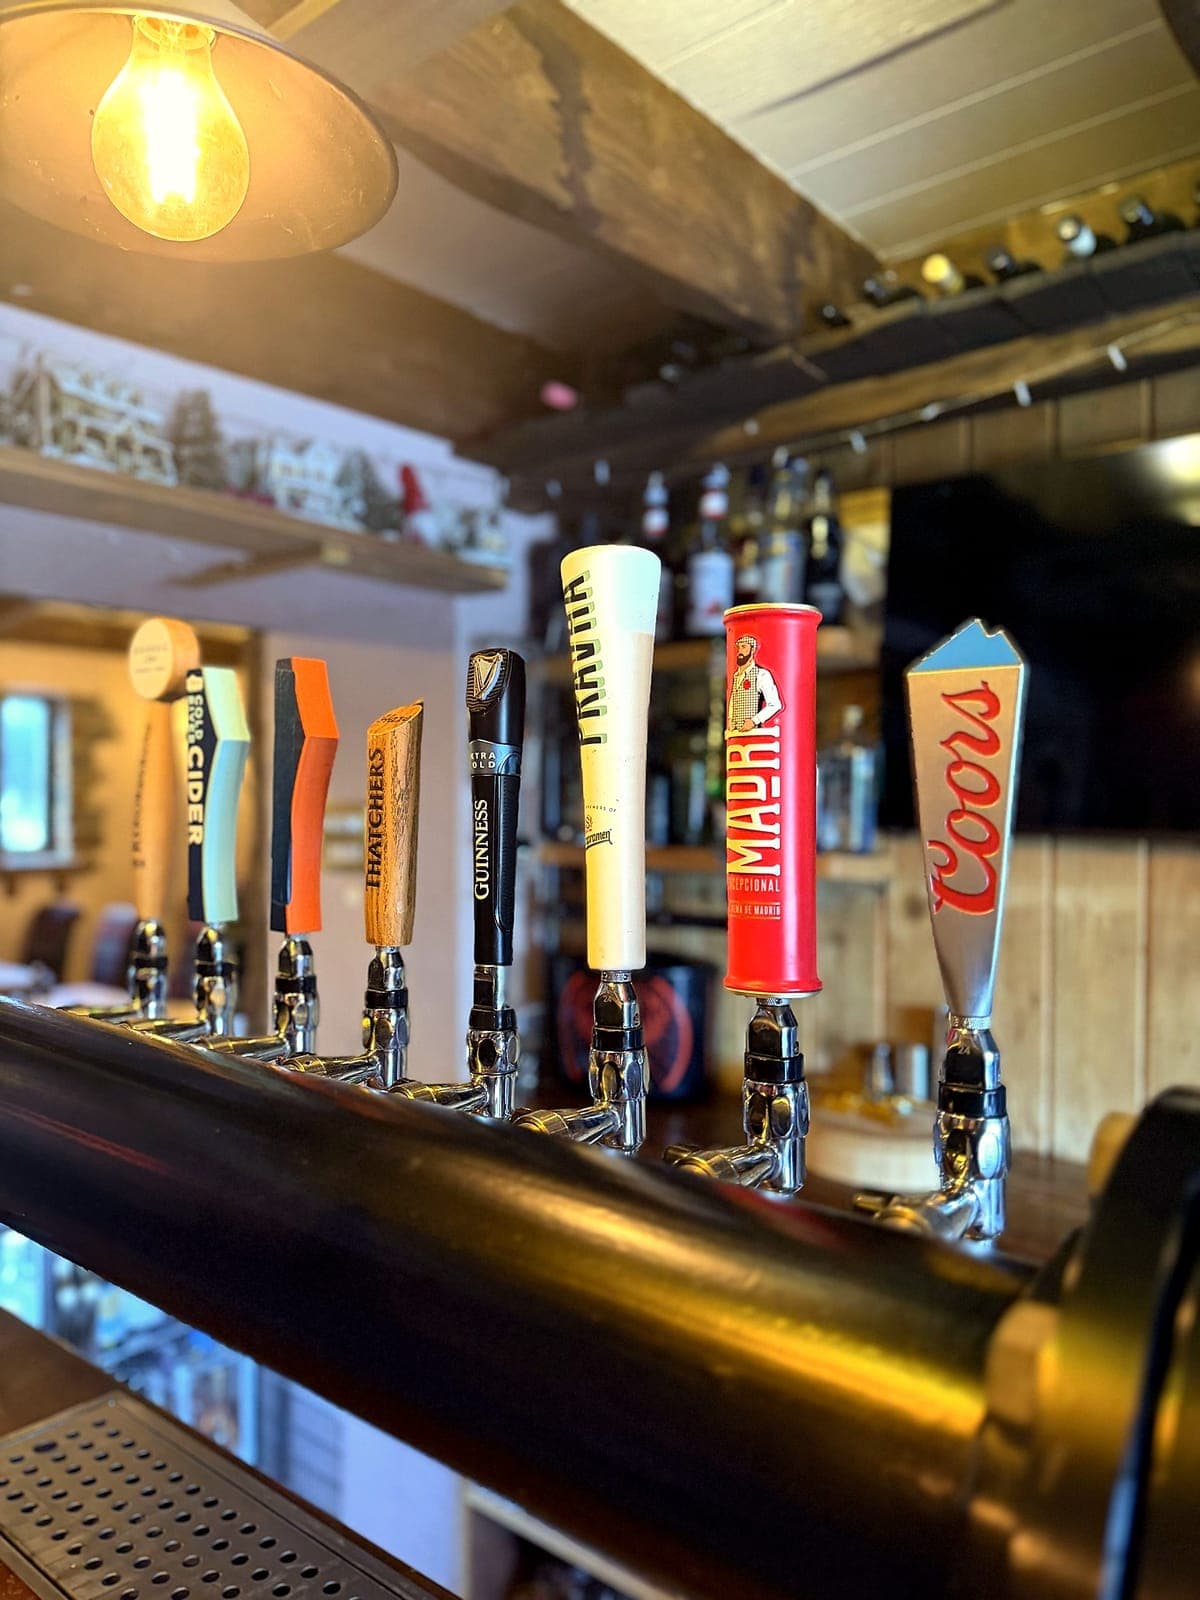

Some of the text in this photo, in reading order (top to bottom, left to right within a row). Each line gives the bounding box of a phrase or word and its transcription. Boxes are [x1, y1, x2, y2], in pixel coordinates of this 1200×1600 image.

[188, 745, 204, 844] CIDER
[366, 747, 385, 891] THATCHERS
[927, 680, 1001, 915] Coors
[474, 799, 490, 901] GUINNESS
[753, 905, 781, 916] MADRID
